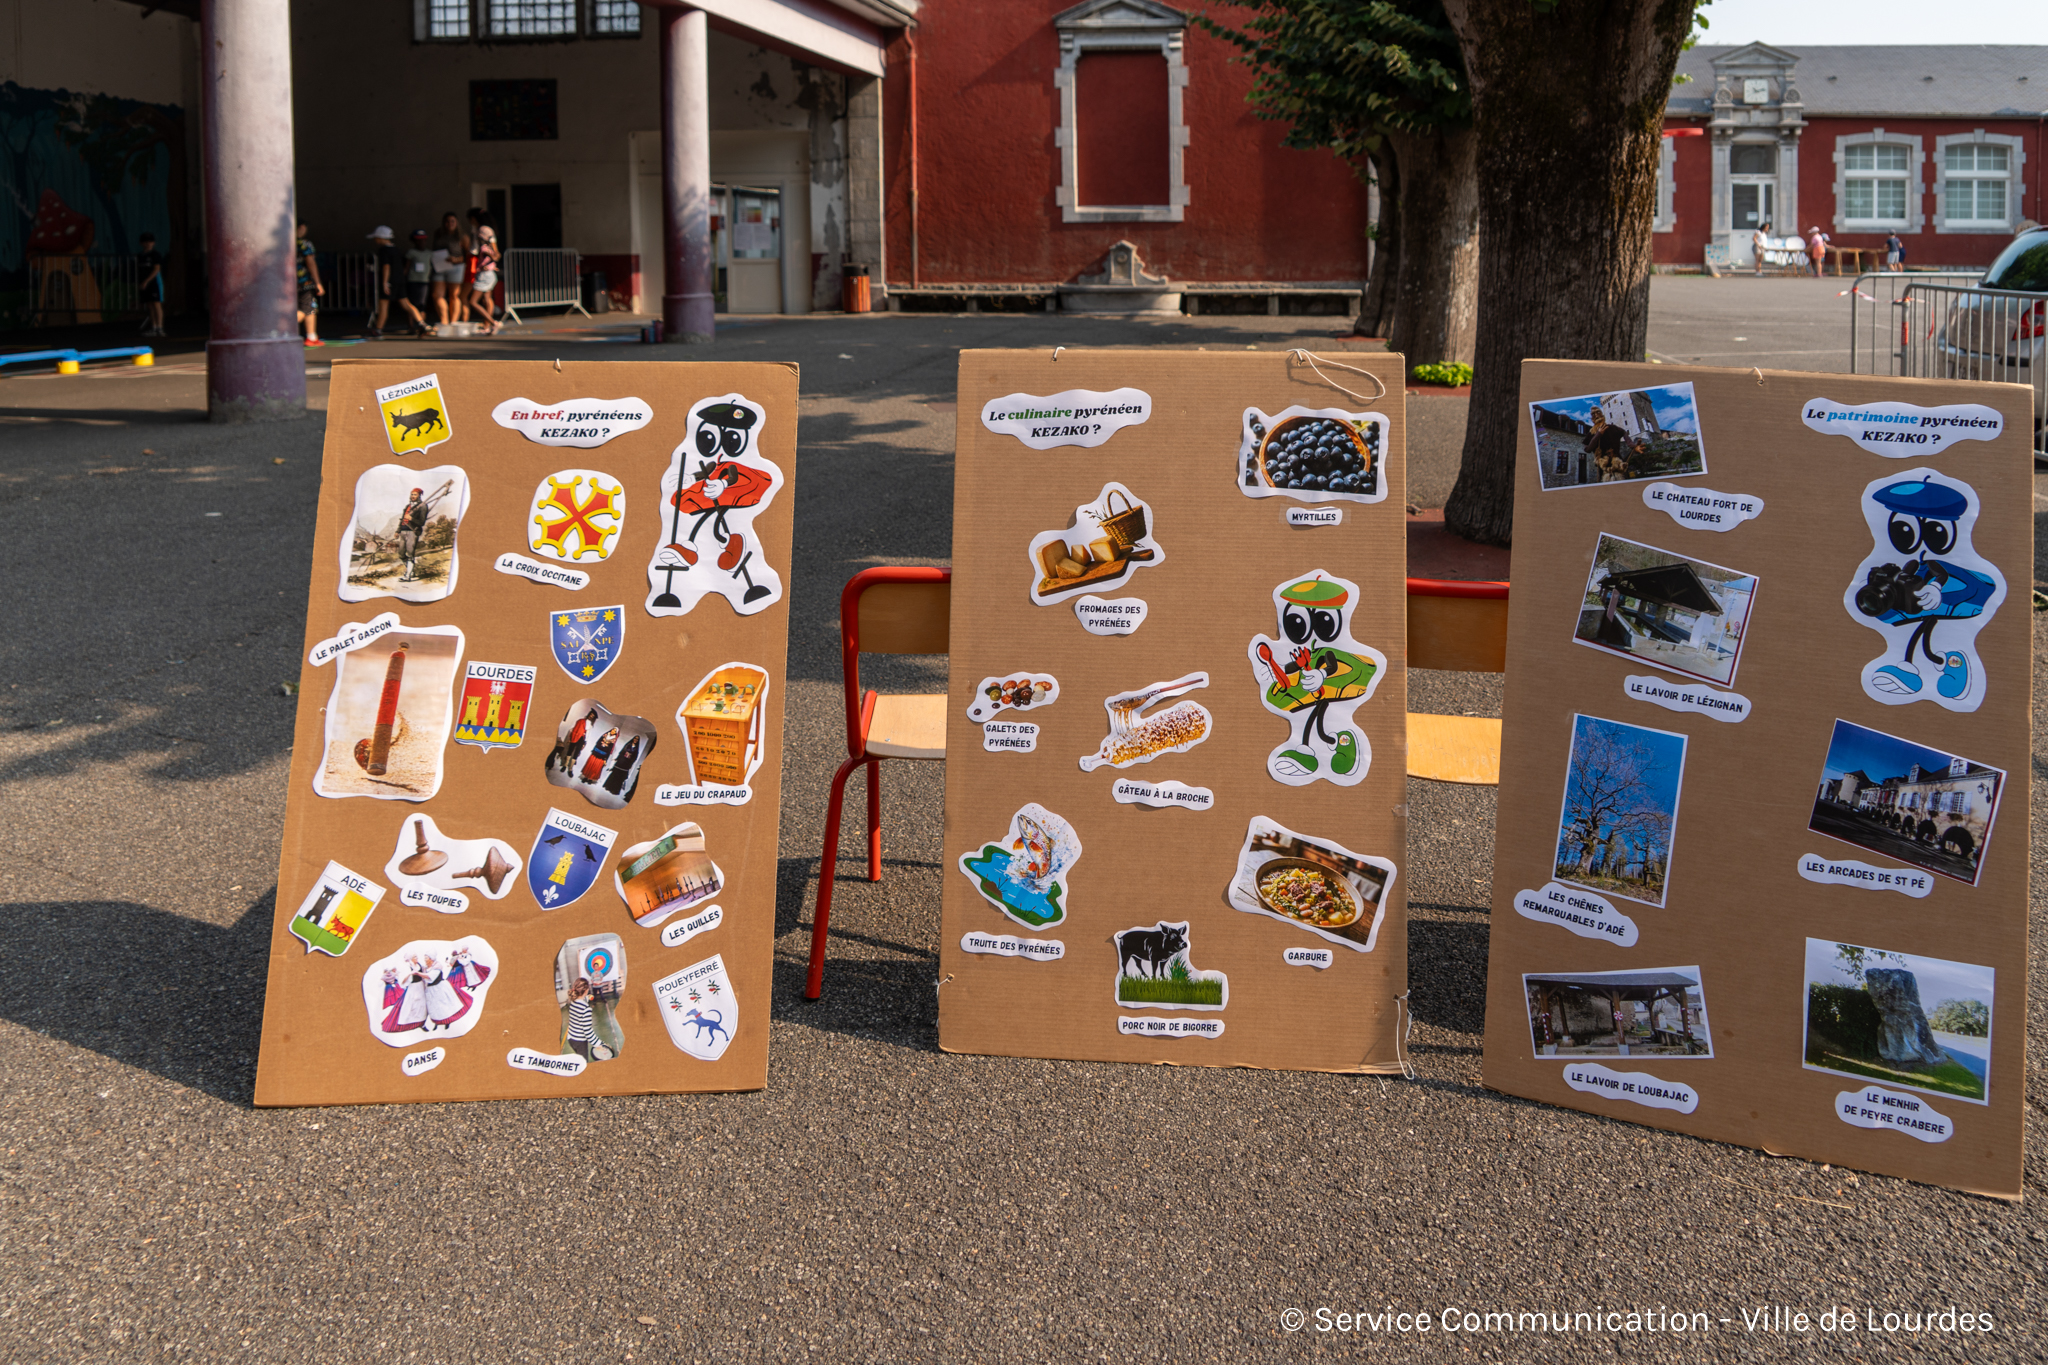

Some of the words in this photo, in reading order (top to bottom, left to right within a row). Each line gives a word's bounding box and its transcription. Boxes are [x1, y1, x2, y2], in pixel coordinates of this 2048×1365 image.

[381, 379, 433, 401] LÉZIGNAN
[511, 411, 529, 420] En
[531, 410, 564, 421] bref,
[567, 410, 642, 422] pyrénéens
[989, 412, 1006, 421] Le
[1008, 407, 1072, 420] culinaire
[1074, 404, 1142, 419] pyrénéen
[1807, 409, 1826, 419] Le
[1826, 411, 1919, 424] patrimoine
[1920, 416, 1998, 428] pyrénéen
[540, 428, 598, 438] KEZAKO
[602, 428, 610, 438] ?
[1031, 425, 1089, 438] KEZAKO
[1093, 424, 1102, 434] ?
[1862, 430, 1928, 444] KEZAKO
[1932, 434, 1942, 444] ?
[1652, 490, 1664, 500] LE
[1666, 493, 1710, 506] CHATEAU
[1713, 499, 1738, 510] FORT
[1740, 503, 1753, 512] DE
[1292, 513, 1336, 521] MYRTILLES
[1680, 510, 1721, 523] LOURDES
[502, 559, 513, 568] LA
[516, 562, 540, 574] CROIX
[541, 569, 582, 586] OCCITANE
[1080, 605, 1122, 614] FROMAGES
[1125, 606, 1140, 614] DES
[1089, 617, 1130, 628] PYRÉNÉES
[316, 649, 328, 660] LE
[328, 636, 354, 654] PALET
[358, 619, 392, 642] GASCON
[467, 665, 533, 682] LOURDES
[1631, 683, 1643, 693] LE
[1646, 686, 1679, 700] LAVOIR
[1682, 694, 1694, 704] DE
[1697, 695, 1743, 713] LÉZIGNAN
[986, 724, 1017, 733] GALETS
[1019, 726, 1035, 734] DES
[989, 737, 1031, 748] PYRÉNÉES
[661, 791, 672, 800] LE
[674, 791, 691, 799] JEU
[693, 791, 705, 799] DU
[707, 790, 746, 798] CRAPAUD
[1118, 784, 1151, 797] GÂTEAU
[1153, 788, 1160, 798] À
[1162, 791, 1173, 800] LA
[1176, 792, 1209, 804] BROCHE
[554, 816, 606, 842] LOUBAJAC
[341, 873, 367, 892] ADÉ
[1806, 862, 1825, 873] LES
[1828, 866, 1875, 881] ARCADES
[1878, 873, 1892, 884] DE
[1895, 876, 1908, 886] ST
[1911, 877, 1925, 889] PÉ
[407, 890, 424, 900] LES
[427, 894, 462, 908] TOUPIES
[1548, 891, 1566, 903] LES
[1568, 897, 1604, 914] CHÊNES
[669, 927, 687, 941] LES
[686, 910, 720, 932] QUILLES
[1522, 899, 1595, 929] REMARQUABLES
[1597, 922, 1625, 936] D'ADÉ
[969, 938, 998, 949] TRUITE
[1000, 941, 1016, 951] DES
[1018, 943, 1060, 955] PYRÉNÉES
[1288, 952, 1327, 962] GARBURE
[658, 961, 719, 995] POUEYFERRÉ
[1122, 1022, 1144, 1030] PORC
[1147, 1022, 1166, 1030] NOIR
[1169, 1022, 1180, 1031] DE
[1182, 1023, 1218, 1032] BIGORRE
[407, 1052, 437, 1068] DANSE
[513, 1054, 525, 1064] LE
[528, 1056, 580, 1073] TAMBORNET
[1572, 1072, 1583, 1082] LE
[1586, 1075, 1620, 1090] LAVOIR
[1622, 1082, 1635, 1093] DE
[1638, 1085, 1689, 1103] LOUBAJAC
[1867, 1093, 1880, 1104] LE
[1882, 1096, 1920, 1112] MENHIR
[1844, 1105, 1858, 1116] DE
[1861, 1108, 1894, 1123] PEYRE
[1897, 1116, 1945, 1134] CRABERE
